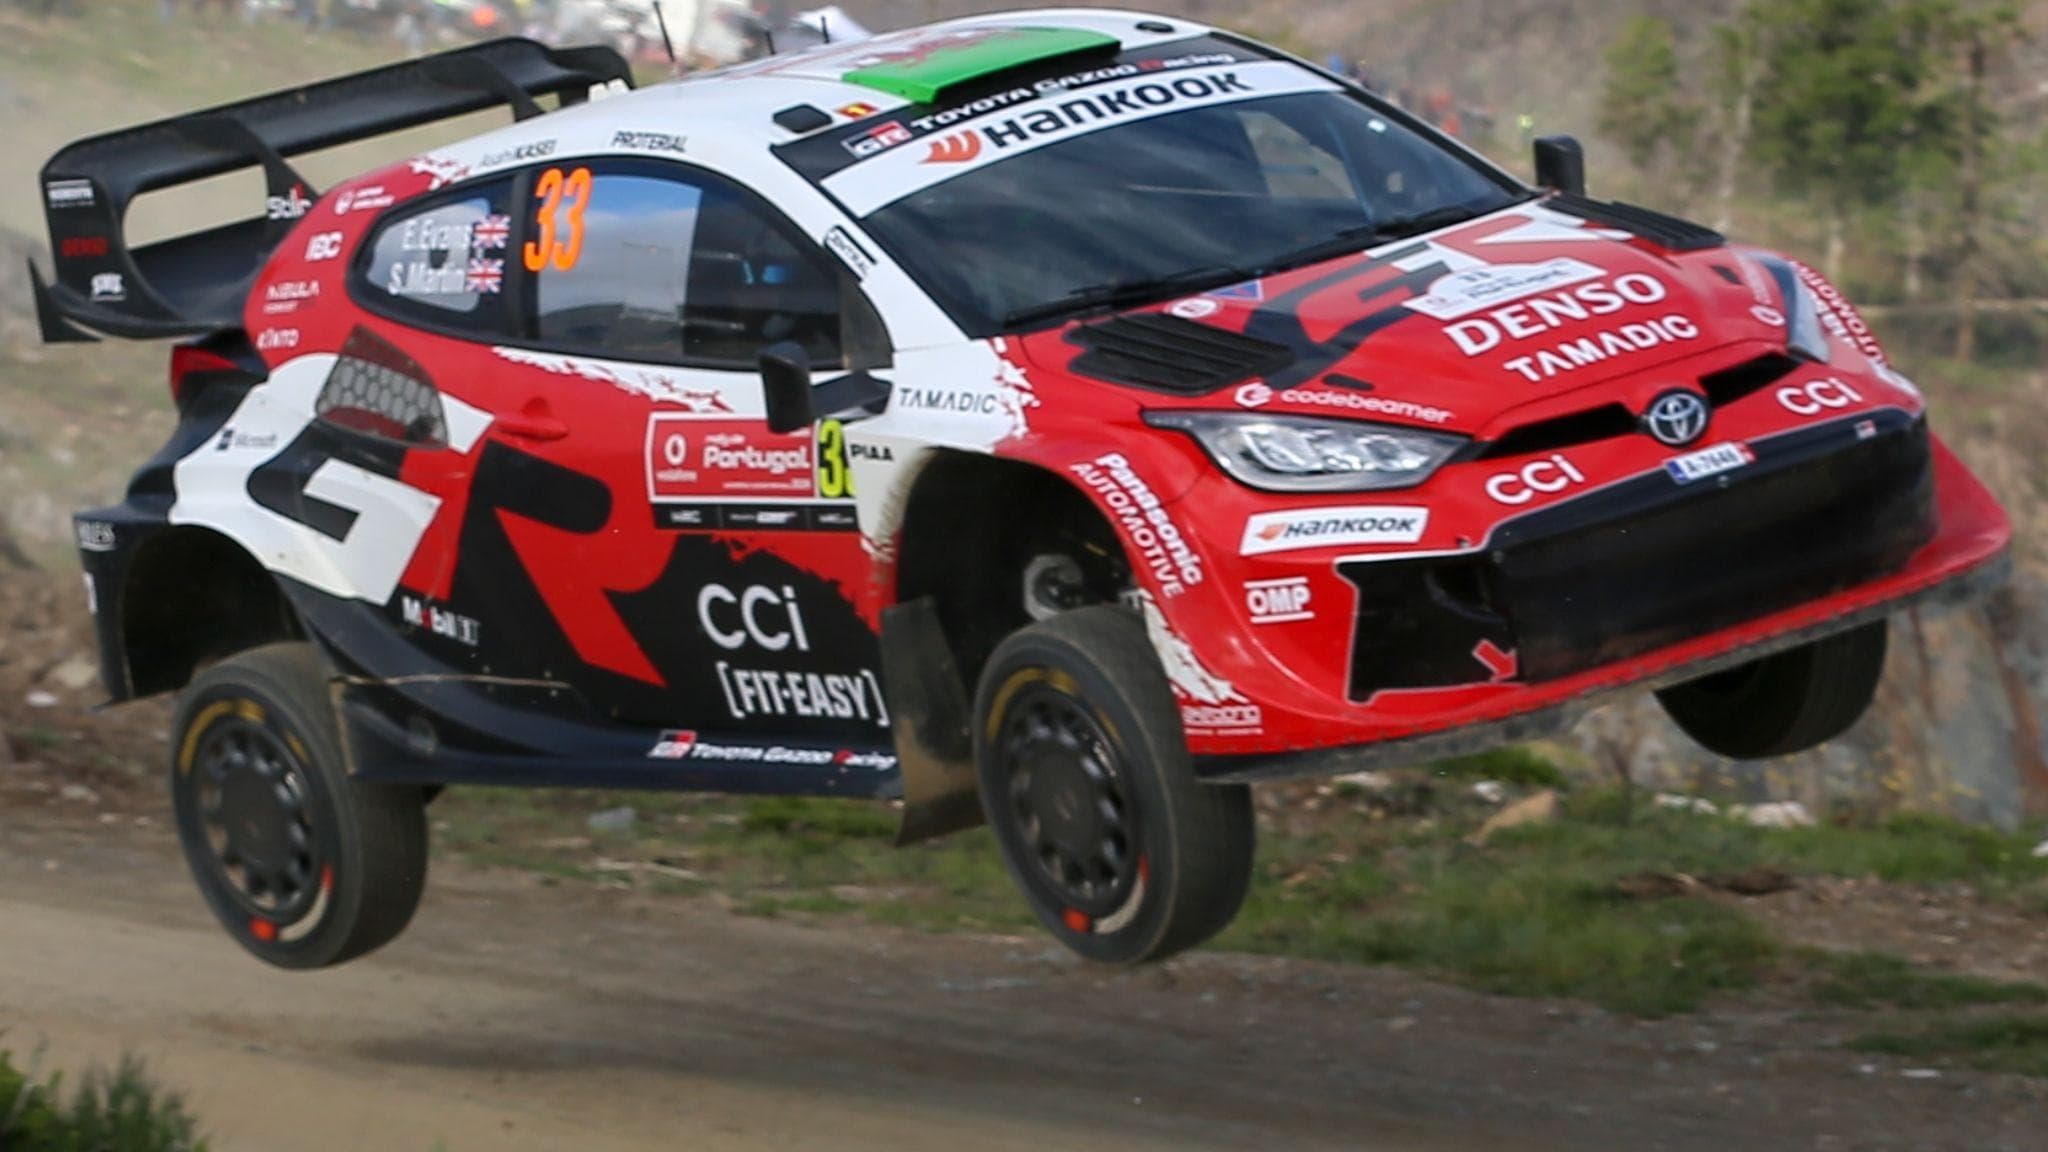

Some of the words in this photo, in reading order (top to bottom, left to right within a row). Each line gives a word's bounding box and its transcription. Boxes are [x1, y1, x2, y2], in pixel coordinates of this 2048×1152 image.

[523, 167, 593, 271] 33
[1443, 272, 1668, 357] DENSO
[1502, 313, 1700, 384] TAMADIC
[899, 386, 998, 414] TAMADIC
[1280, 388, 1454, 425] codebeamer
[702, 445, 811, 474] Portugal
[849, 443, 894, 462] PIAA
[1069, 462, 1187, 600] AUTOMOTIVE
[1094, 453, 1204, 586] Panasonic
[1246, 583, 1312, 616] OMP
